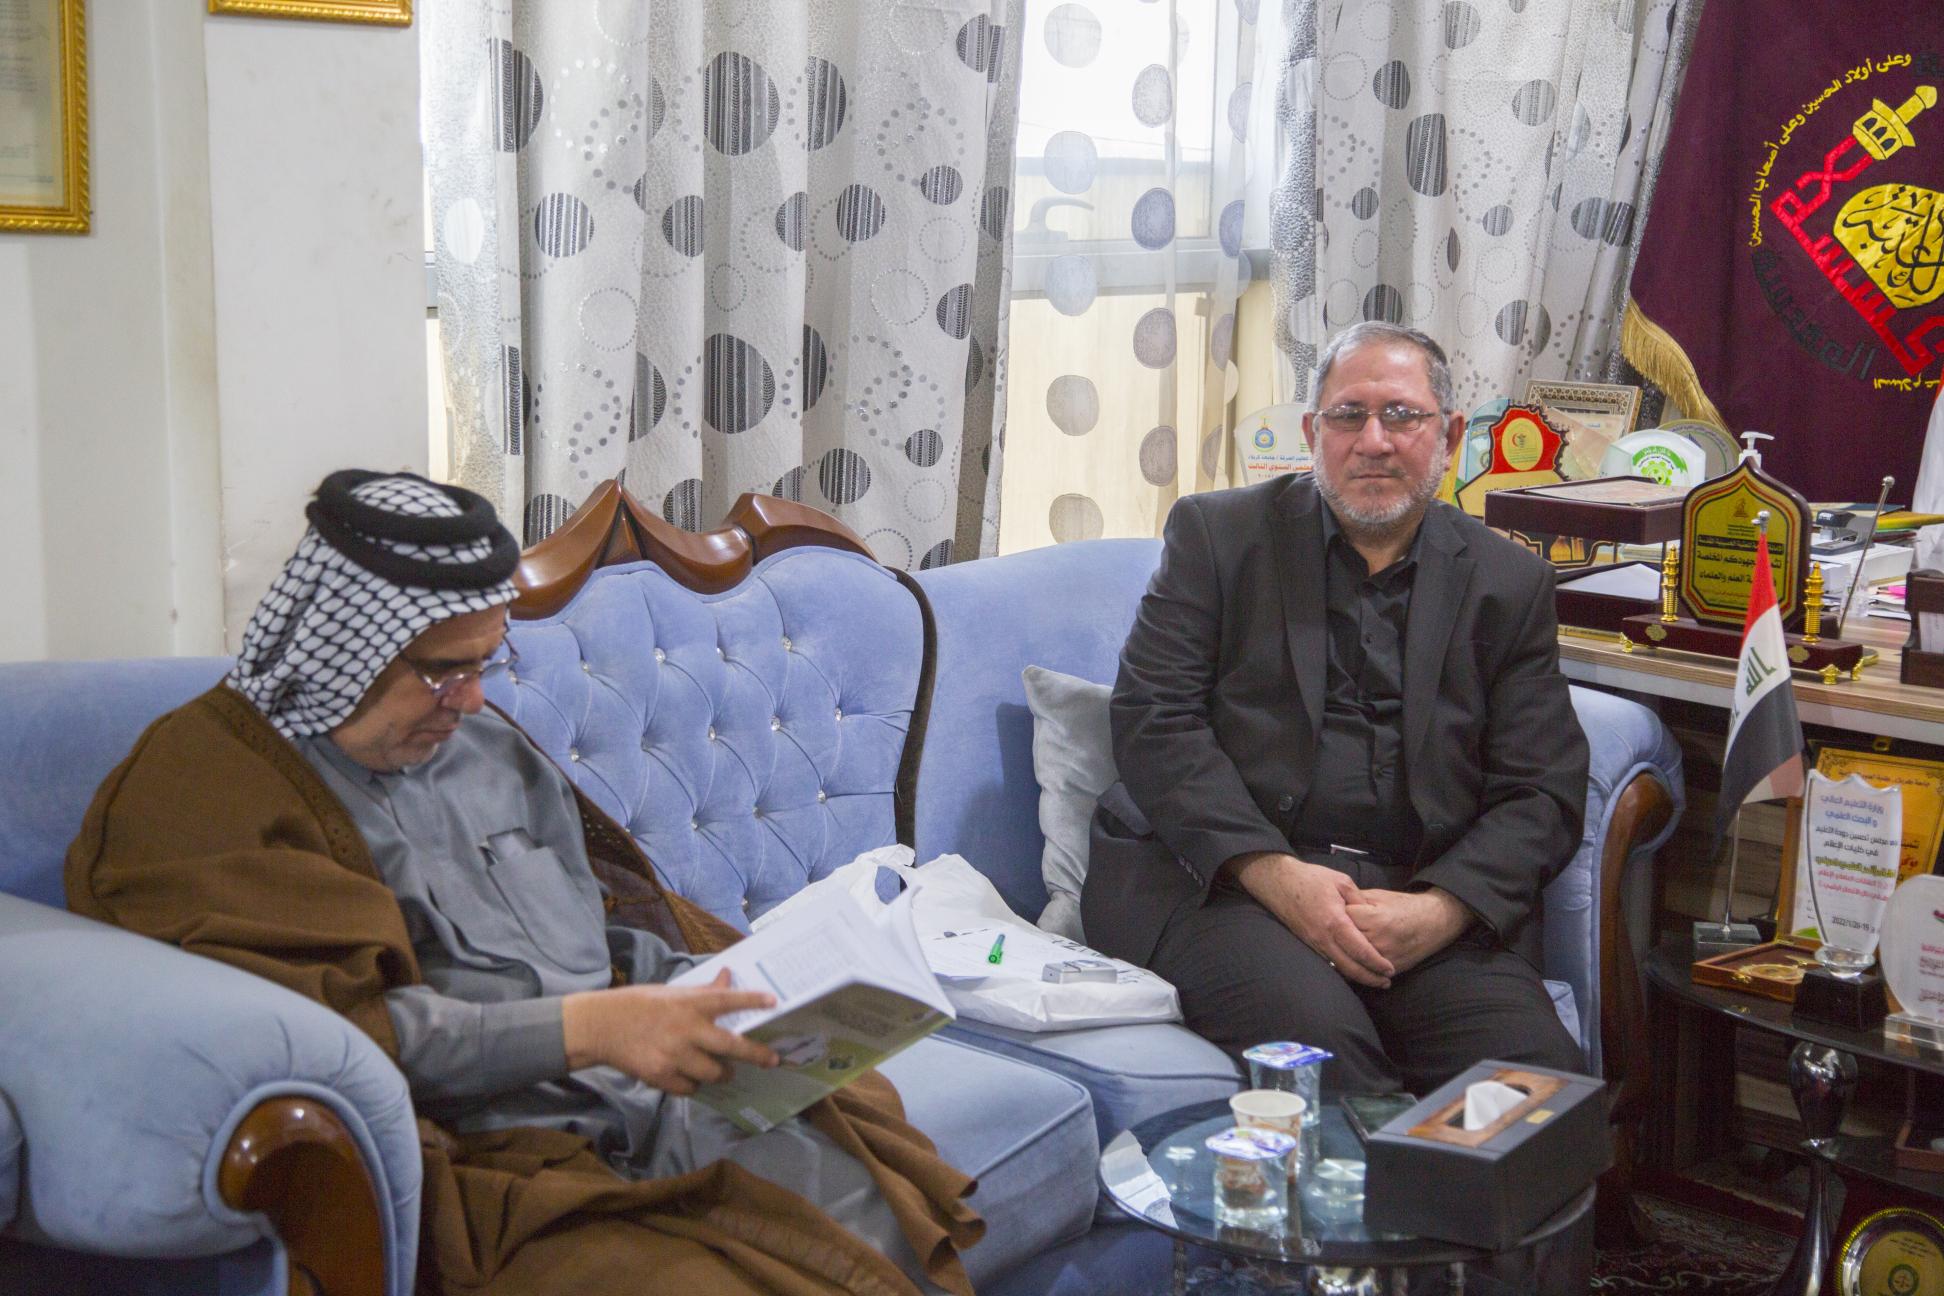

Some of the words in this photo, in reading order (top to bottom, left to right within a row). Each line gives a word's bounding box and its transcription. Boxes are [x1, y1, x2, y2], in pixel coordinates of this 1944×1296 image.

[1845, 58, 1873, 84] أولاد
[1876, 53, 1912, 73] وعلى
[1802, 79, 1842, 115] الحسين
[1779, 113, 1807, 145] وعلى
[1753, 141, 1780, 192] أصحاب
[1748, 193, 1763, 247] الحسين
[1873, 372, 1921, 391] السلام
